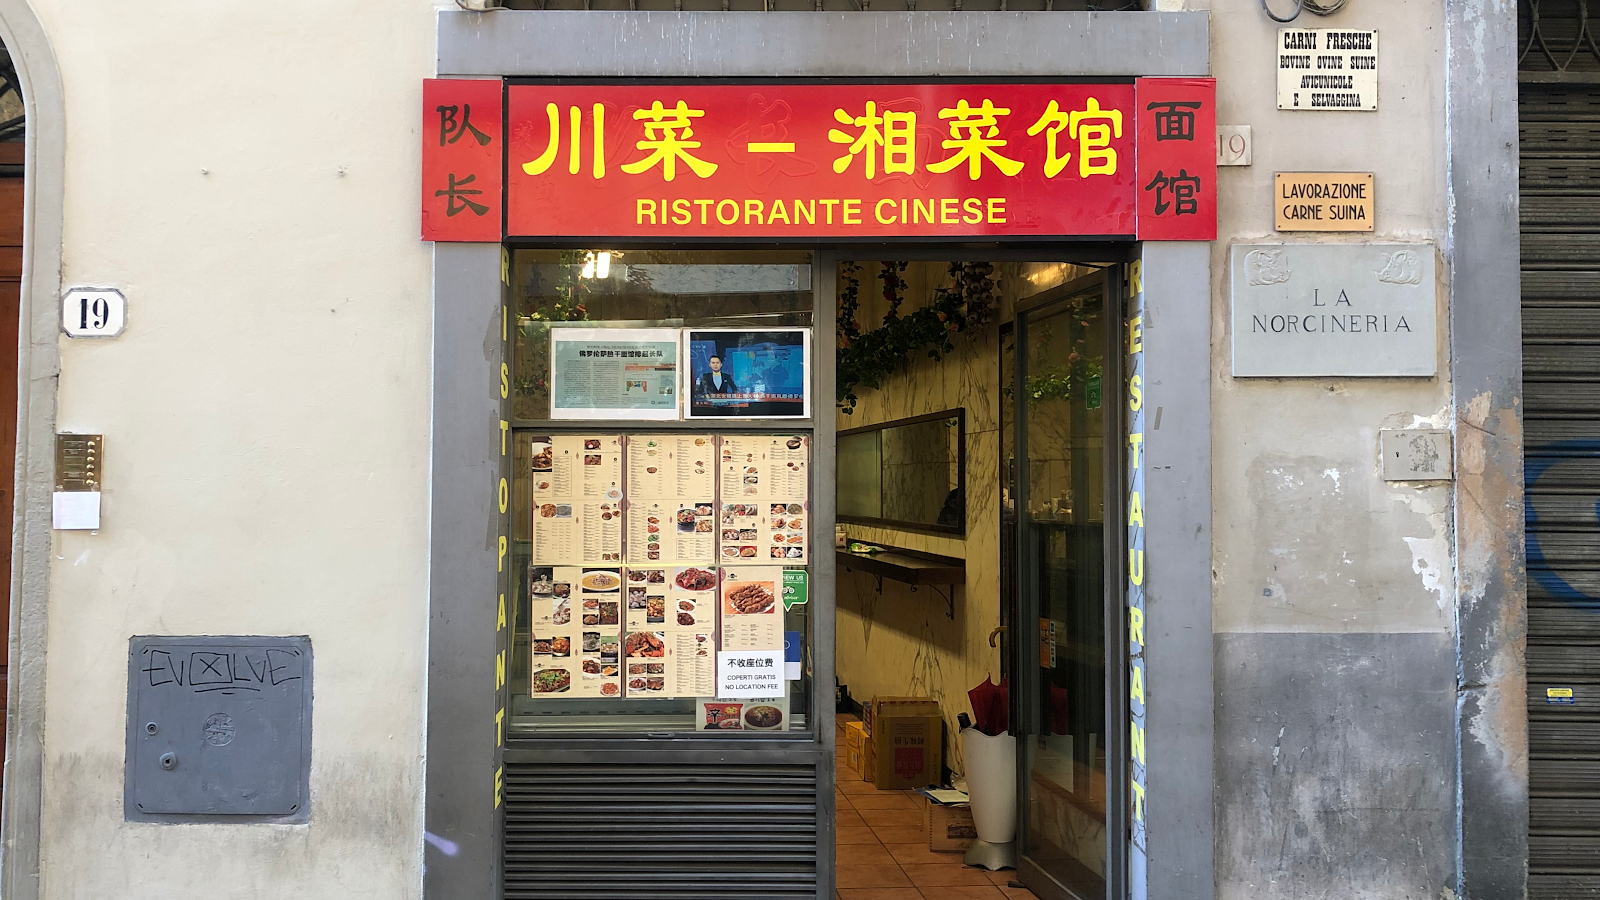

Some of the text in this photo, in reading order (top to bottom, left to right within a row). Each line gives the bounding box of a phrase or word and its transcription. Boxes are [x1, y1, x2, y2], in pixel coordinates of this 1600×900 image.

[1283, 33, 1372, 50] CARNI FRESCHE
[1280, 56, 1376, 70] BOVINE OVINE SUINE
[1300, 75, 1353, 89] AVICUNICOLE
[1294, 93, 1361, 107] E SELVAGGINA
[1219, 133, 1246, 163] 19
[434, 104, 492, 218] 队长
[1145, 101, 1202, 216] 面馆
[1282, 183, 1367, 200] LAVORAZIONE
[635, 197, 1007, 226] RISTORANTE CINESE
[1283, 205, 1365, 221] CARNE SUINA
[1313, 288, 1353, 307] LA
[79, 298, 109, 330] 19
[1252, 314, 1412, 333] NORCINERIA
[1129, 258, 1145, 822] RESTAURANT
[727, 657, 774, 668] 不收座位费
